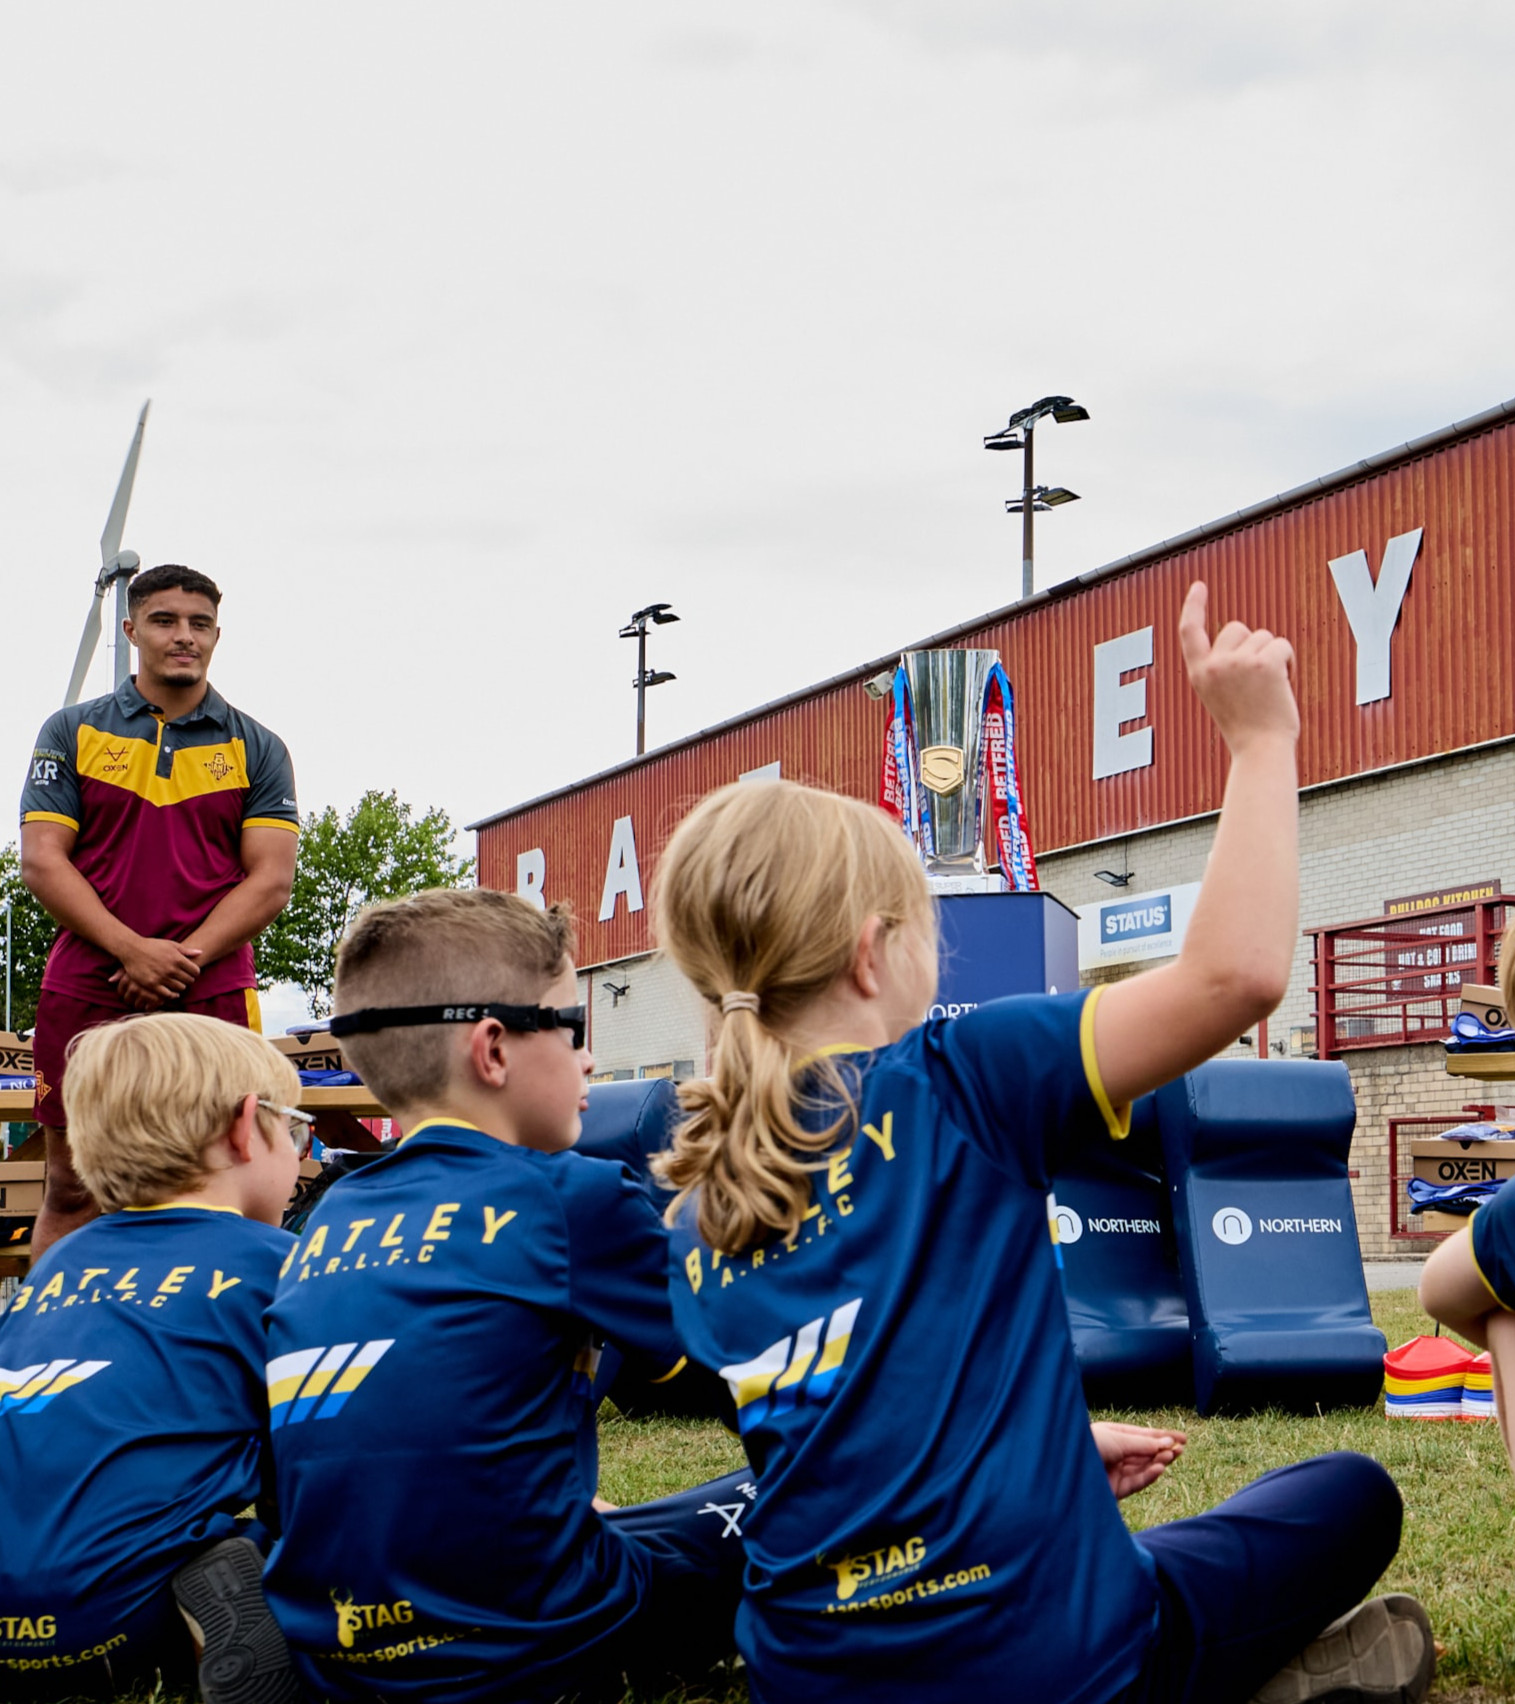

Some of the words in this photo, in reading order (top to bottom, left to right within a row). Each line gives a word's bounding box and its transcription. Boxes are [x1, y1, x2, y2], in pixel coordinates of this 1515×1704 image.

[989, 712, 1008, 800] BETFRED
[31, 759, 58, 780] KR
[103, 764, 128, 772] OXEN
[1424, 971, 1461, 989] SNAKS
[443, 1008, 477, 1020] REC
[0, 1051, 34, 1071] XE
[293, 1054, 343, 1071] XEN
[1438, 1161, 1497, 1181] OXEN
[1088, 1218, 1161, 1234] NORTHERN
[1259, 1218, 1343, 1234] NORTHERN
[852, 1536, 927, 1582] STAG
[346, 1600, 414, 1632] STAG
[0, 1615, 57, 1640] TAG
